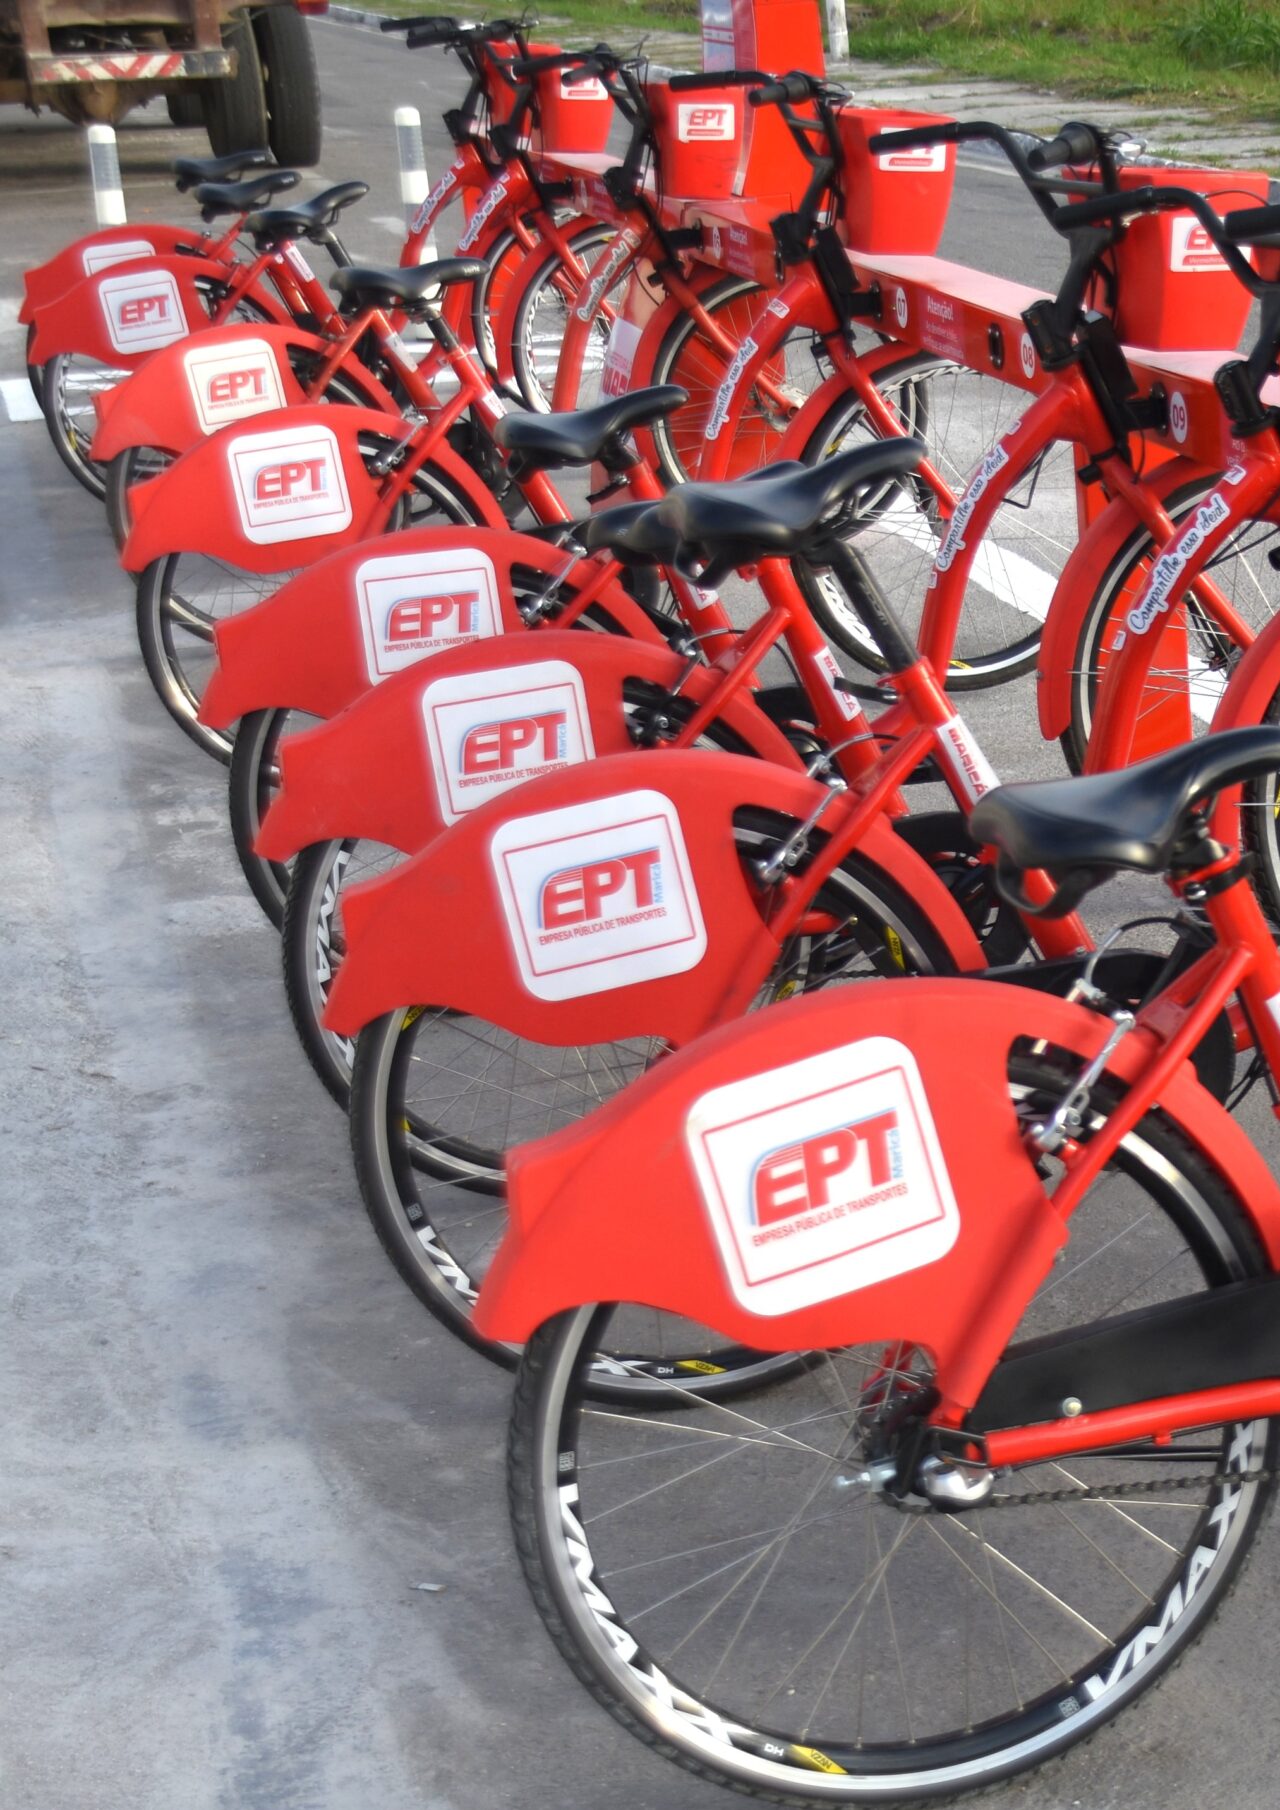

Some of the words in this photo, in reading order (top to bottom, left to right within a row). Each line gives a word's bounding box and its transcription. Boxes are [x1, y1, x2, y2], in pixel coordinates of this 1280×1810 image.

[688, 108, 727, 126] EPT
[119, 294, 170, 326] EPT
[1022, 343, 1034, 369] 08
[209, 367, 267, 403] EPT
[1172, 404, 1185, 430] 09
[256, 457, 326, 500] EPT
[937, 501, 971, 569] Compartilhe
[970, 478, 984, 498] essa
[1130, 557, 1182, 630] Compartilhe
[1182, 532, 1198, 555] essa
[388, 591, 480, 642] EPT
[384, 641, 409, 653] EMPRESA
[433, 638, 441, 647] DE
[463, 711, 567, 775] EPT
[458, 774, 489, 788] EMPRESA
[489, 771, 515, 783] PÚBLICA
[516, 769, 525, 779] DE
[543, 848, 661, 930] EPT
[538, 928, 574, 946] EMPRESA
[573, 923, 604, 938] PÚBLICA
[605, 919, 616, 930] DE
[616, 907, 668, 929] TRANSPORTES
[755, 1110, 899, 1228] EPT
[752, 1223, 796, 1247] EMPRESA
[795, 1208, 833, 1233] PÚBLICA
[833, 1205, 847, 1219] DE
[847, 1182, 909, 1214] TRANSPORTES
[657, 1366, 674, 1375] DH
[558, 1482, 760, 1747] VMAXX
[763, 1742, 785, 1757] DH
